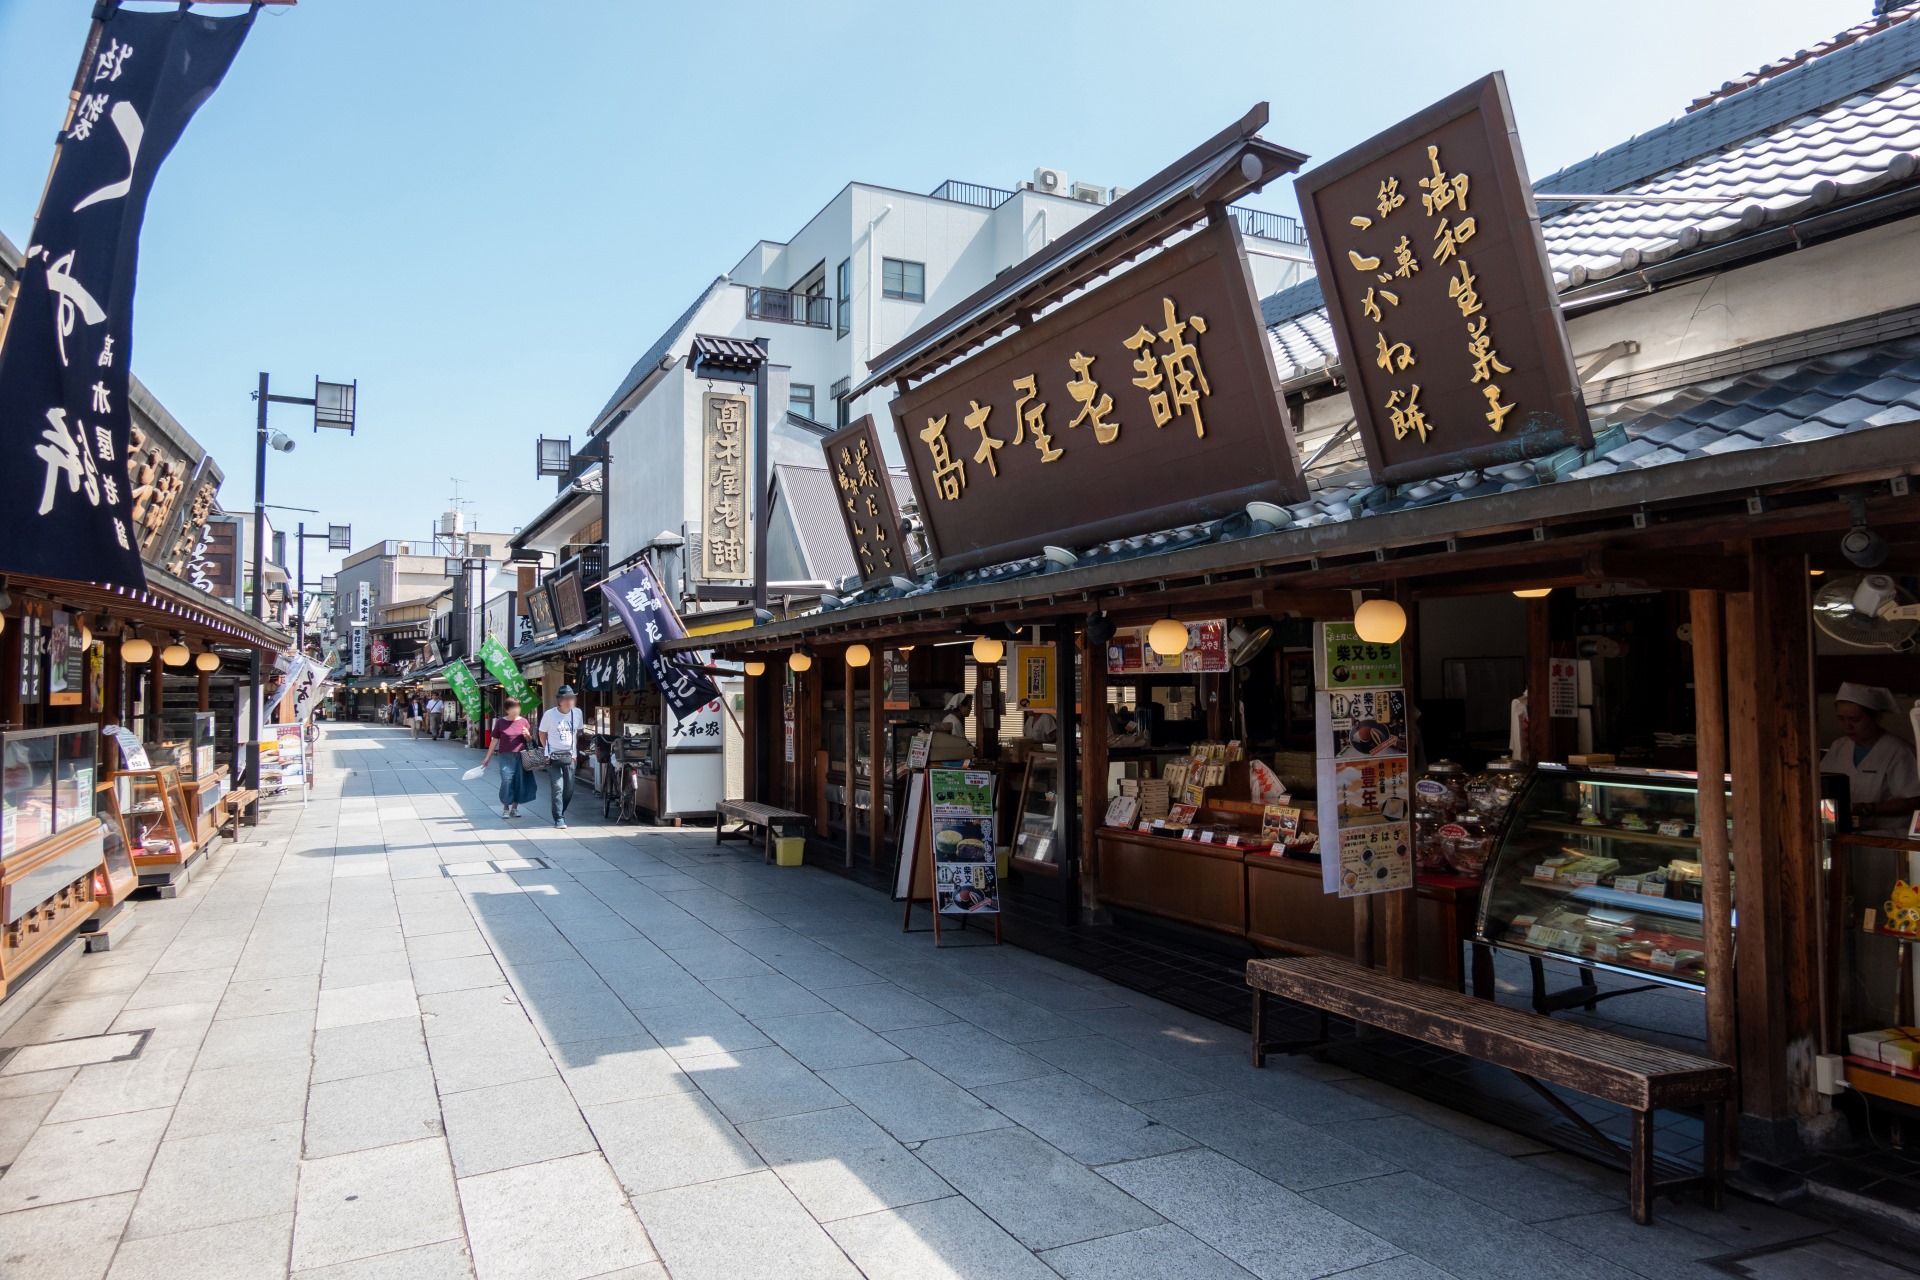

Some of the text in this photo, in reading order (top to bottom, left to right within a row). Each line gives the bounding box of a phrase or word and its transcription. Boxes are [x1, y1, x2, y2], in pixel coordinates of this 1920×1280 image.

[1377, 177, 1421, 279] 銘菓
[1418, 145, 1517, 432] 御和生菓子
[1349, 215, 1434, 443] こがね餅
[1336, 644, 1391, 662] 柴又もち
[1363, 692, 1374, 718] 柴又
[672, 721, 720, 738] 大和家
[946, 791, 985, 801] 柴又もち
[1360, 766, 1378, 811] 豊年
[1370, 829, 1402, 843] おはぎ
[963, 866, 972, 884] 柴又
